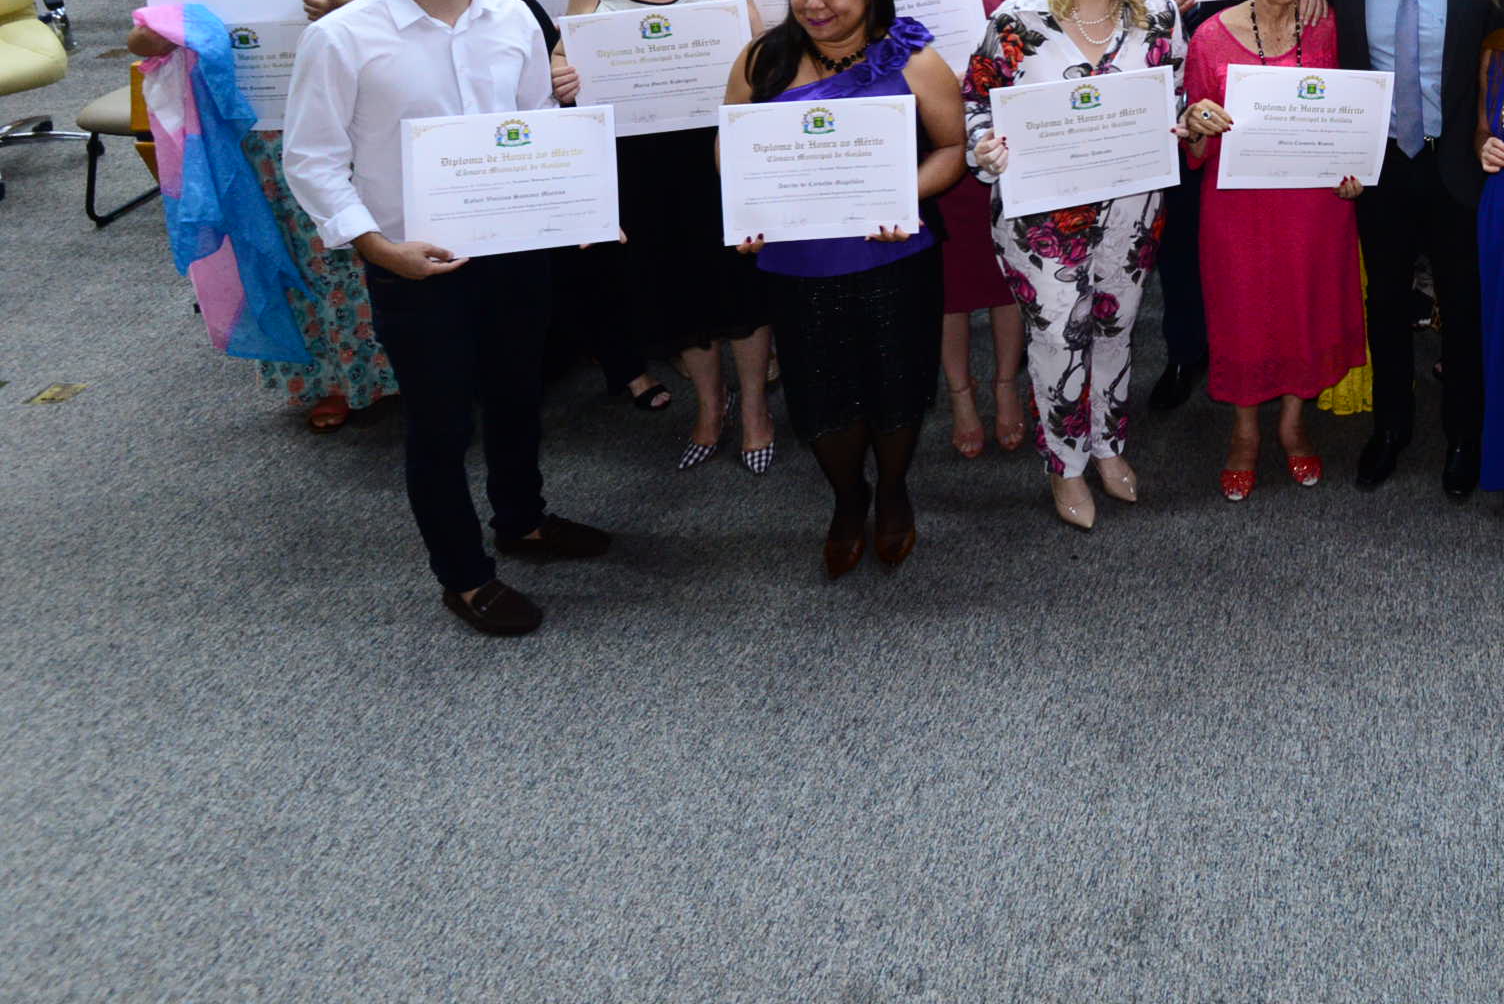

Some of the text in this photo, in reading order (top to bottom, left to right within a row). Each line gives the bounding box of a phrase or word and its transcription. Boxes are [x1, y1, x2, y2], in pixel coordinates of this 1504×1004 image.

[634, 45, 644, 55] de
[1288, 103, 1297, 112] de
[1064, 115, 1073, 125] de
[793, 140, 804, 150] de
[485, 153, 497, 163] de
